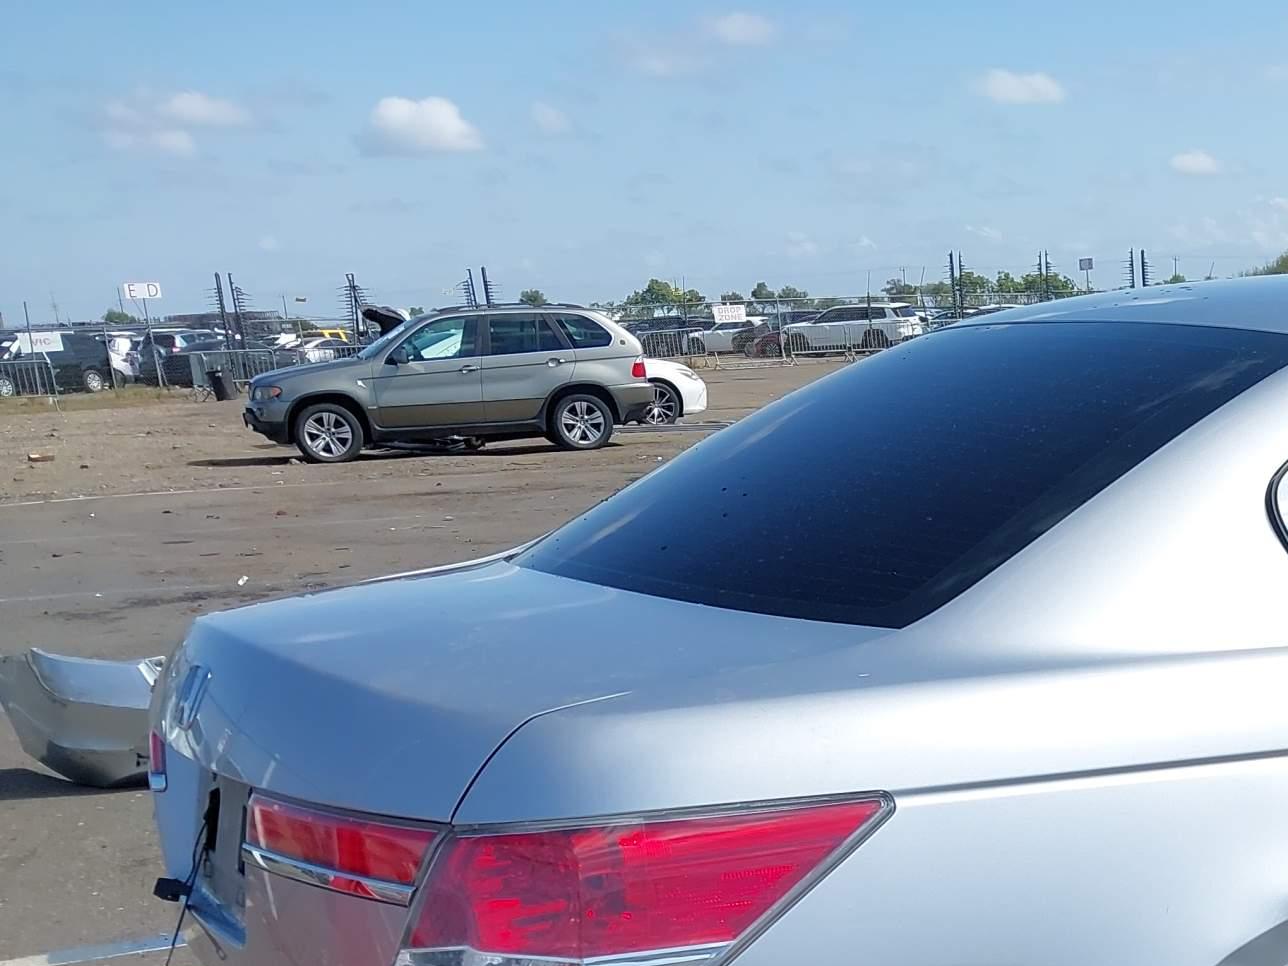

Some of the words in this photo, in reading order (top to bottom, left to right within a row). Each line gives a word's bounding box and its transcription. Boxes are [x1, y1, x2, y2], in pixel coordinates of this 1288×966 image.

[128, 283, 137, 298] E
[146, 283, 158, 298] D
[717, 306, 742, 314] DROP
[719, 313, 743, 321] ZONE
